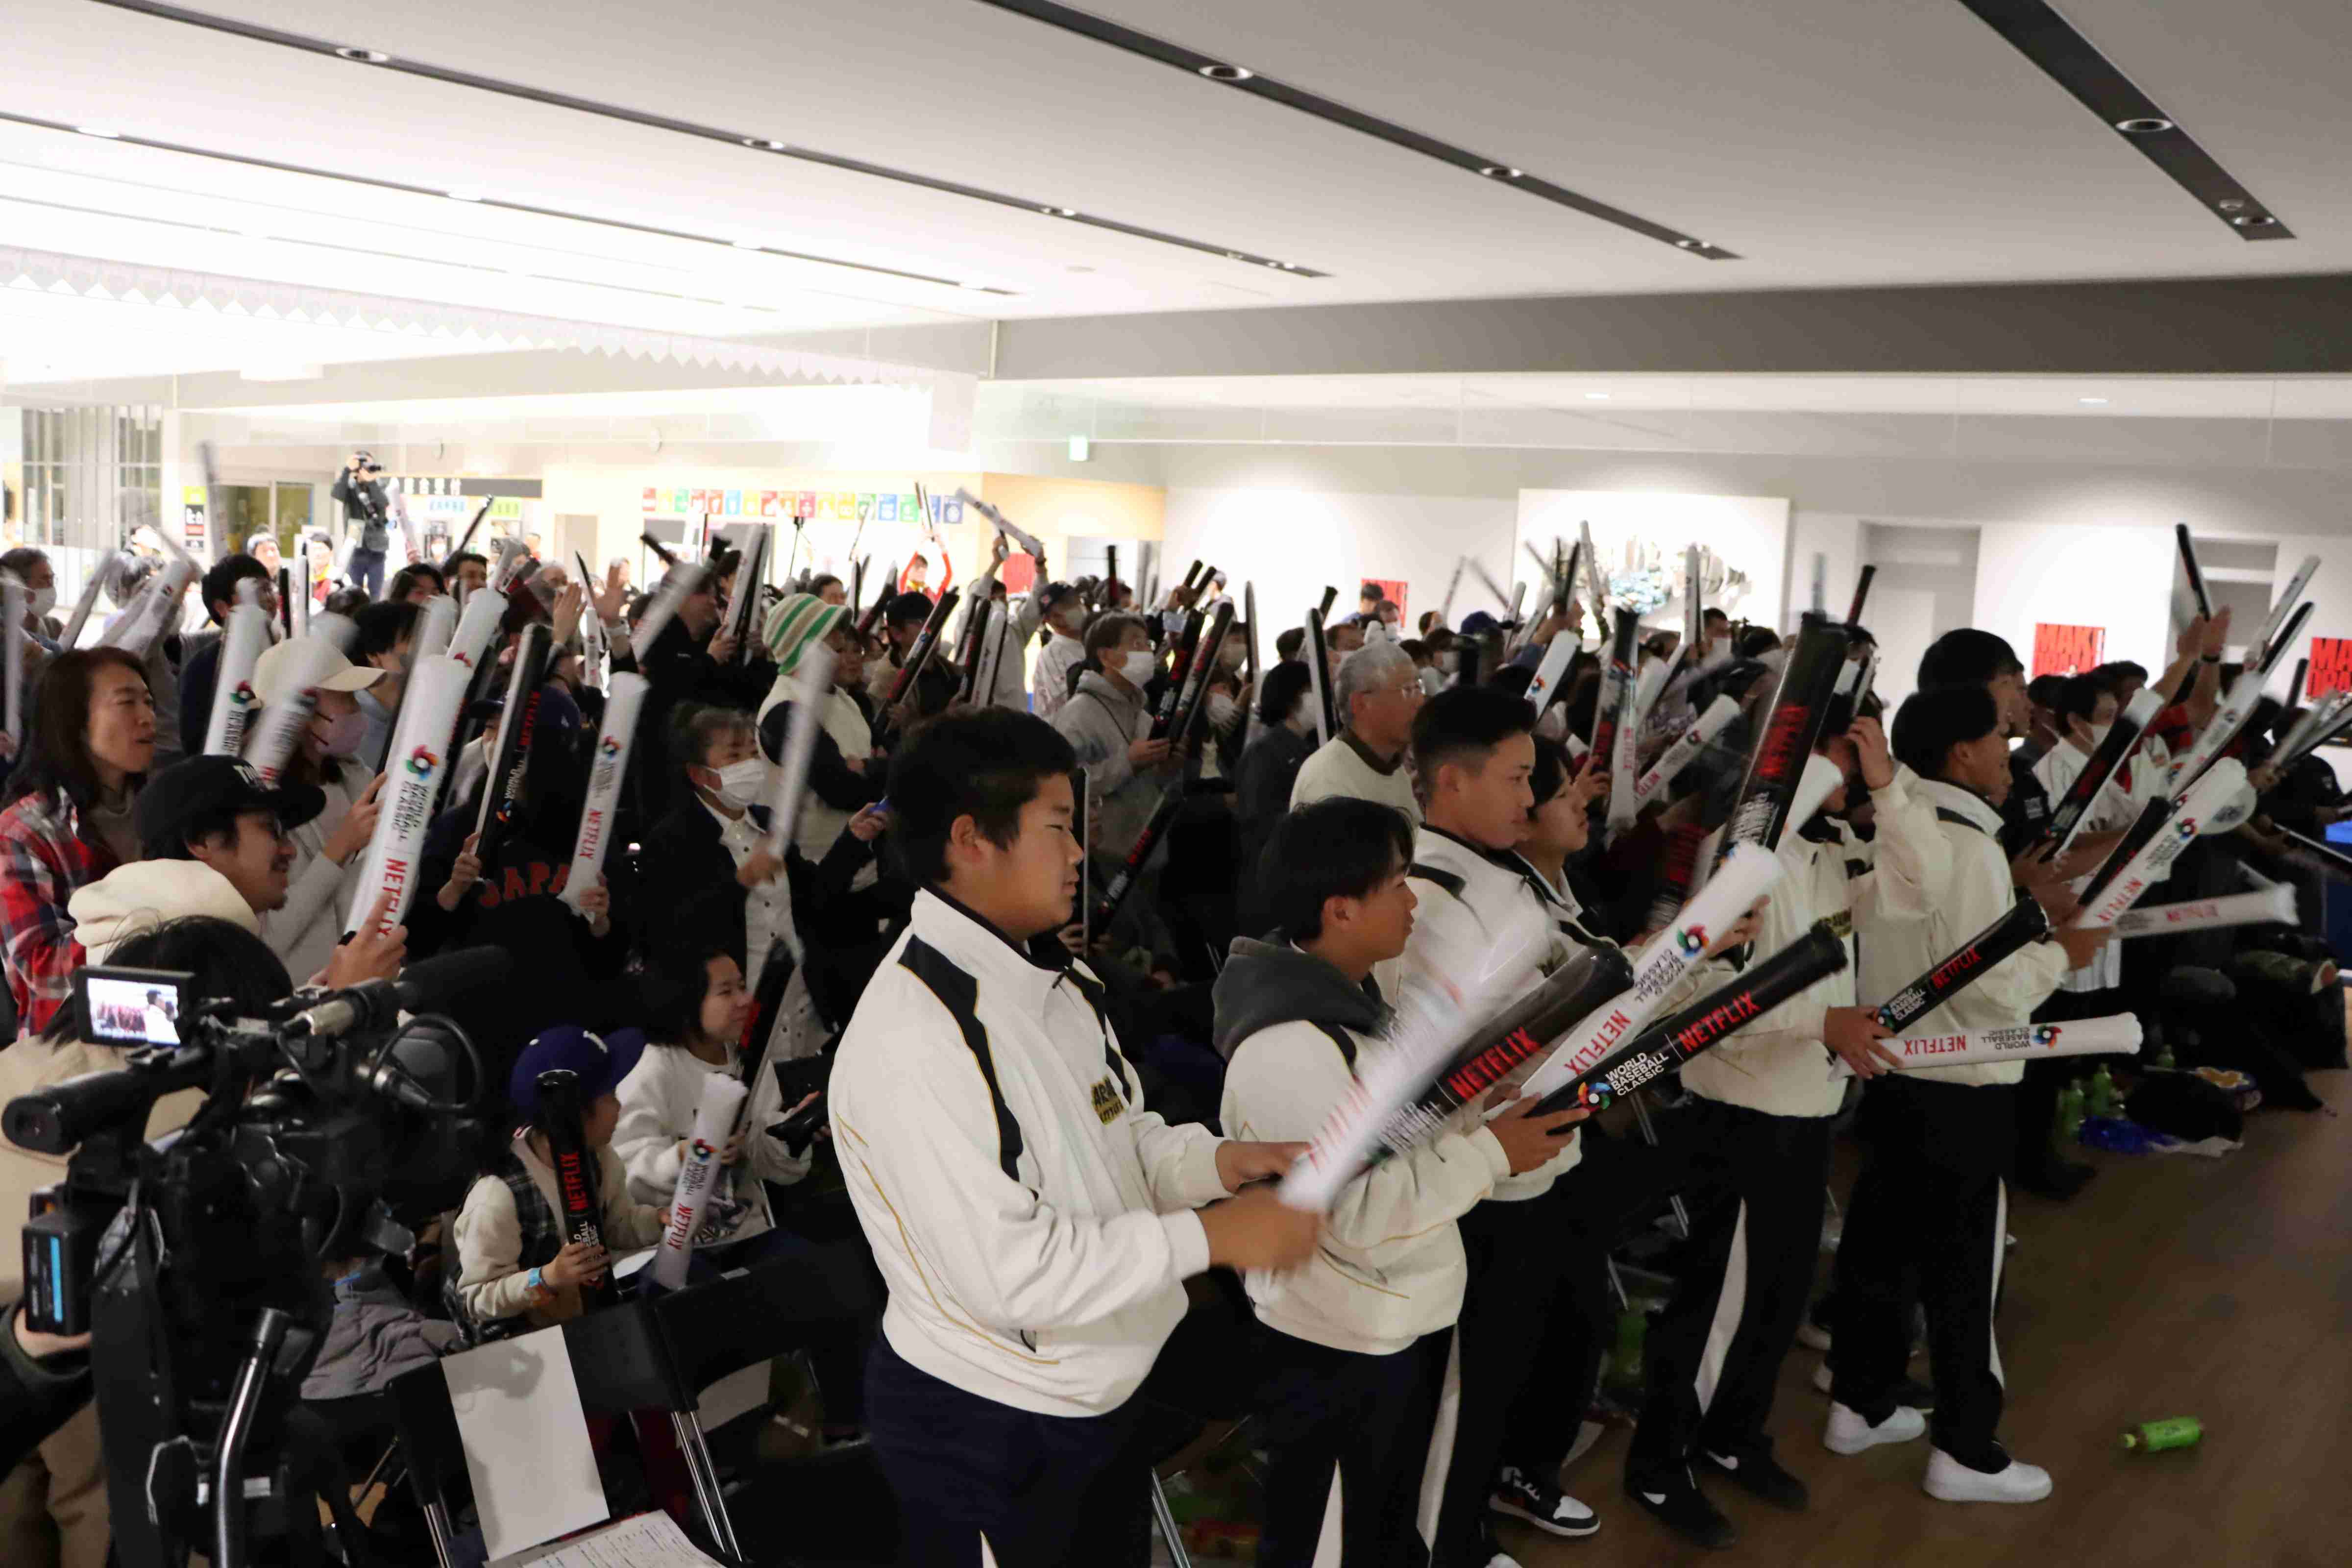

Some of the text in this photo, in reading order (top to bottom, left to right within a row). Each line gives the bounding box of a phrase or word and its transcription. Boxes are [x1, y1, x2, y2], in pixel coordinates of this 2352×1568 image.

[1677, 989, 1761, 1052] NETFLIX
[1981, 1032, 2031, 1044] BASEBALL
[1989, 1026, 2031, 1036] CLASSIC
[1564, 1009, 1631, 1075] NETFLIX
[1904, 1034, 1966, 1055] NETFLIX
[1995, 1040, 2031, 1051] WORLD
[1447, 1026, 1543, 1102] NETFLIX
[1605, 1052, 1648, 1082] WORLD
[1611, 1052, 1669, 1091] BASEBALL
[1617, 1065, 1665, 1097] CLASSIC
[560, 1152, 588, 1212] NETFLIX
[667, 1203, 694, 1250] NETFLIX
